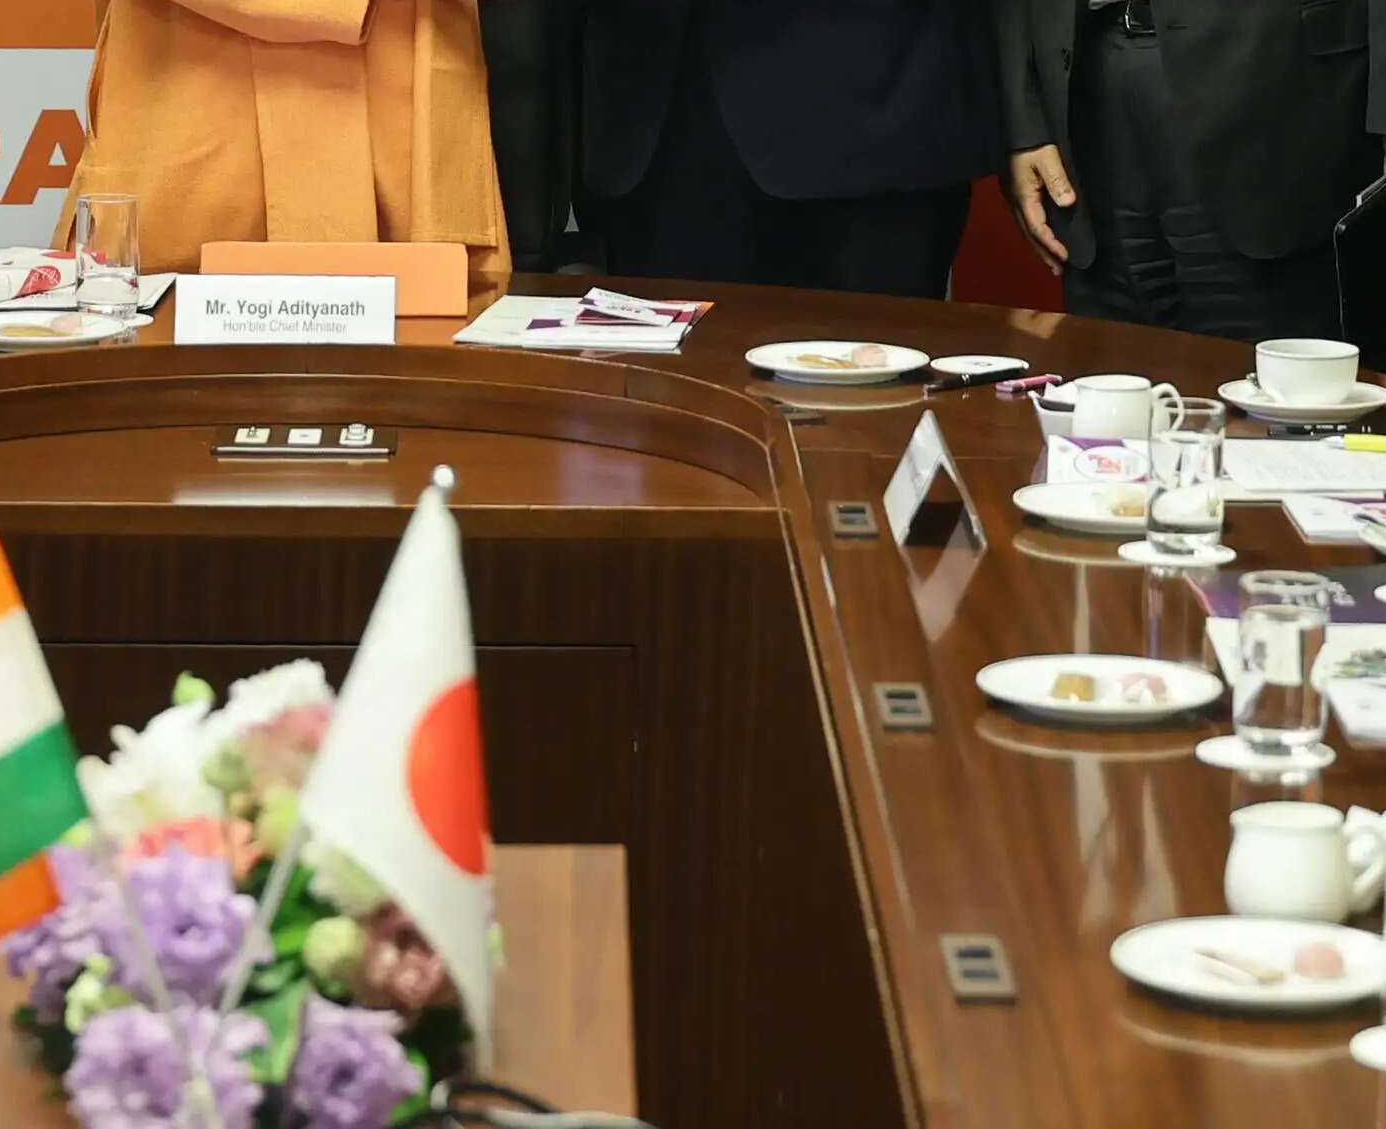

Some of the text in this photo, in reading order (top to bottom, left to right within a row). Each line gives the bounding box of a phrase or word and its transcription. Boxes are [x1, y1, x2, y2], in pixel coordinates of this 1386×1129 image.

[205, 299, 366, 319] Mr. Yogi Adityanath
[223, 319, 347, 333] Hon'ble Chief Minister
